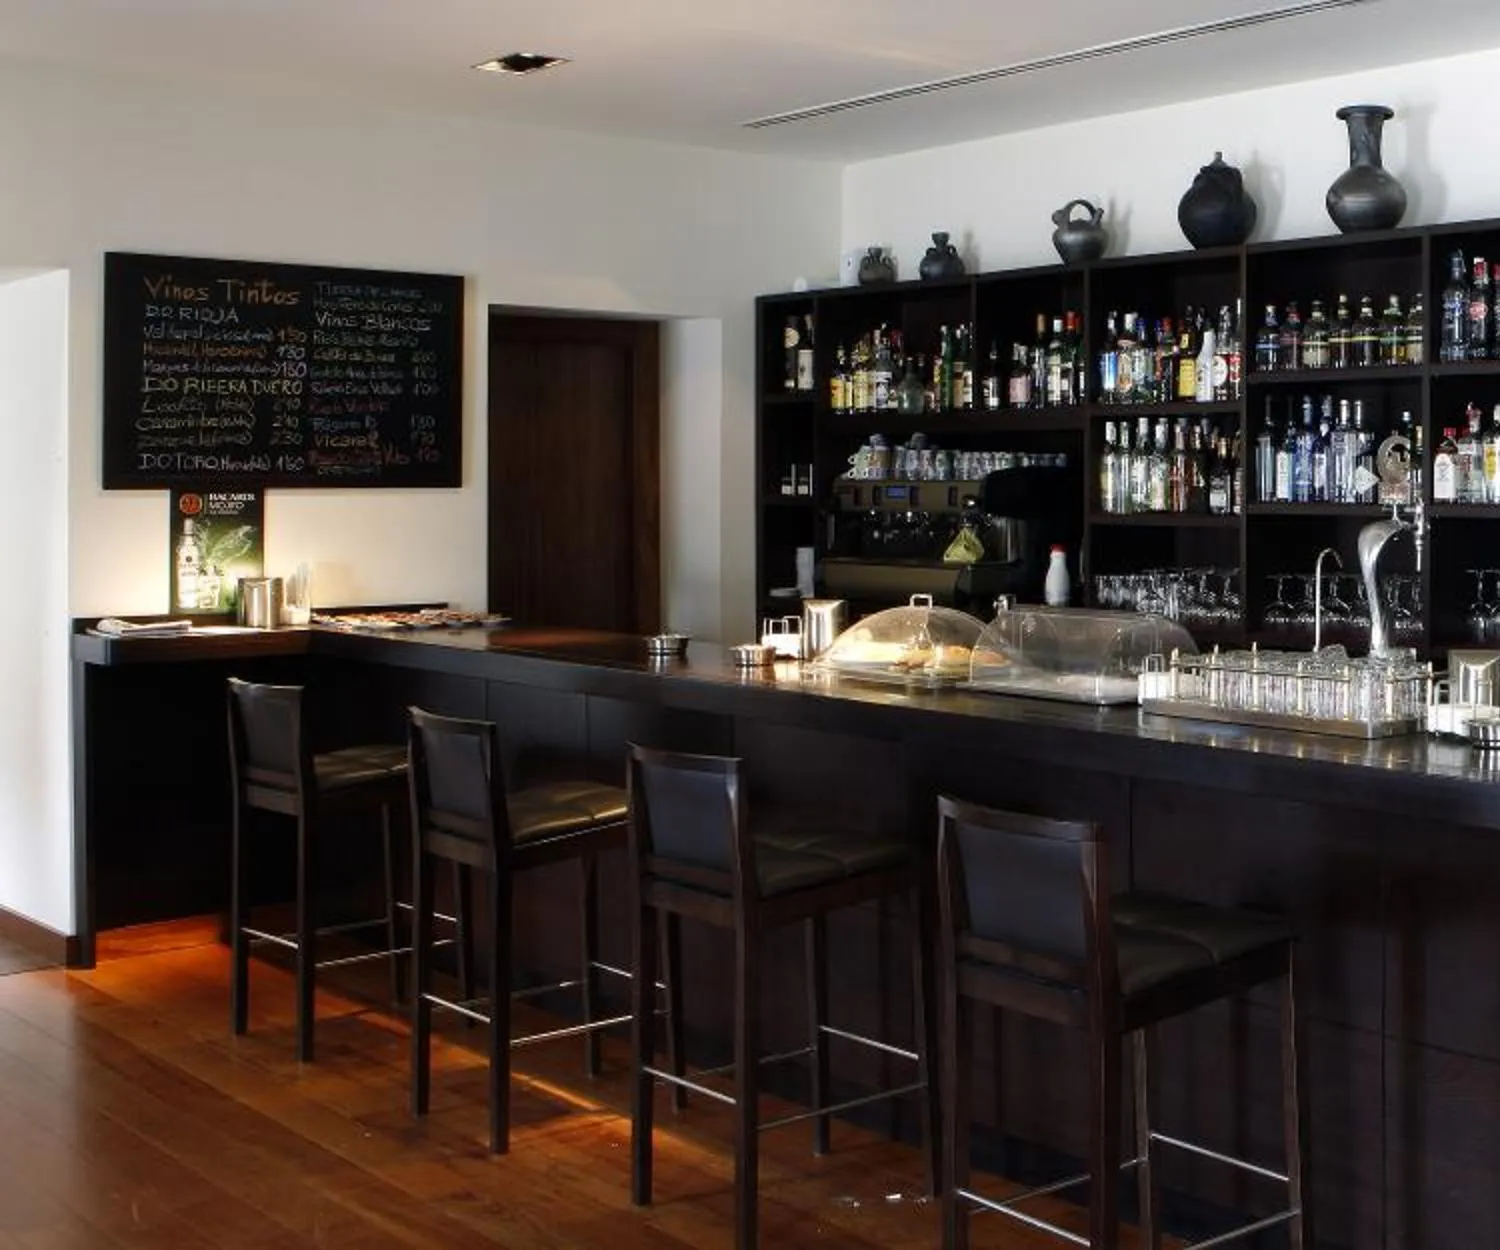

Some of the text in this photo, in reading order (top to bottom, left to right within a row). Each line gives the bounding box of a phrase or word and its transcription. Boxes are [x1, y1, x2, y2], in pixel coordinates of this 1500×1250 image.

[143, 274, 210, 301] Vinos
[216, 279, 302, 305] Tintos
[179, 306, 239, 325] RIOJA
